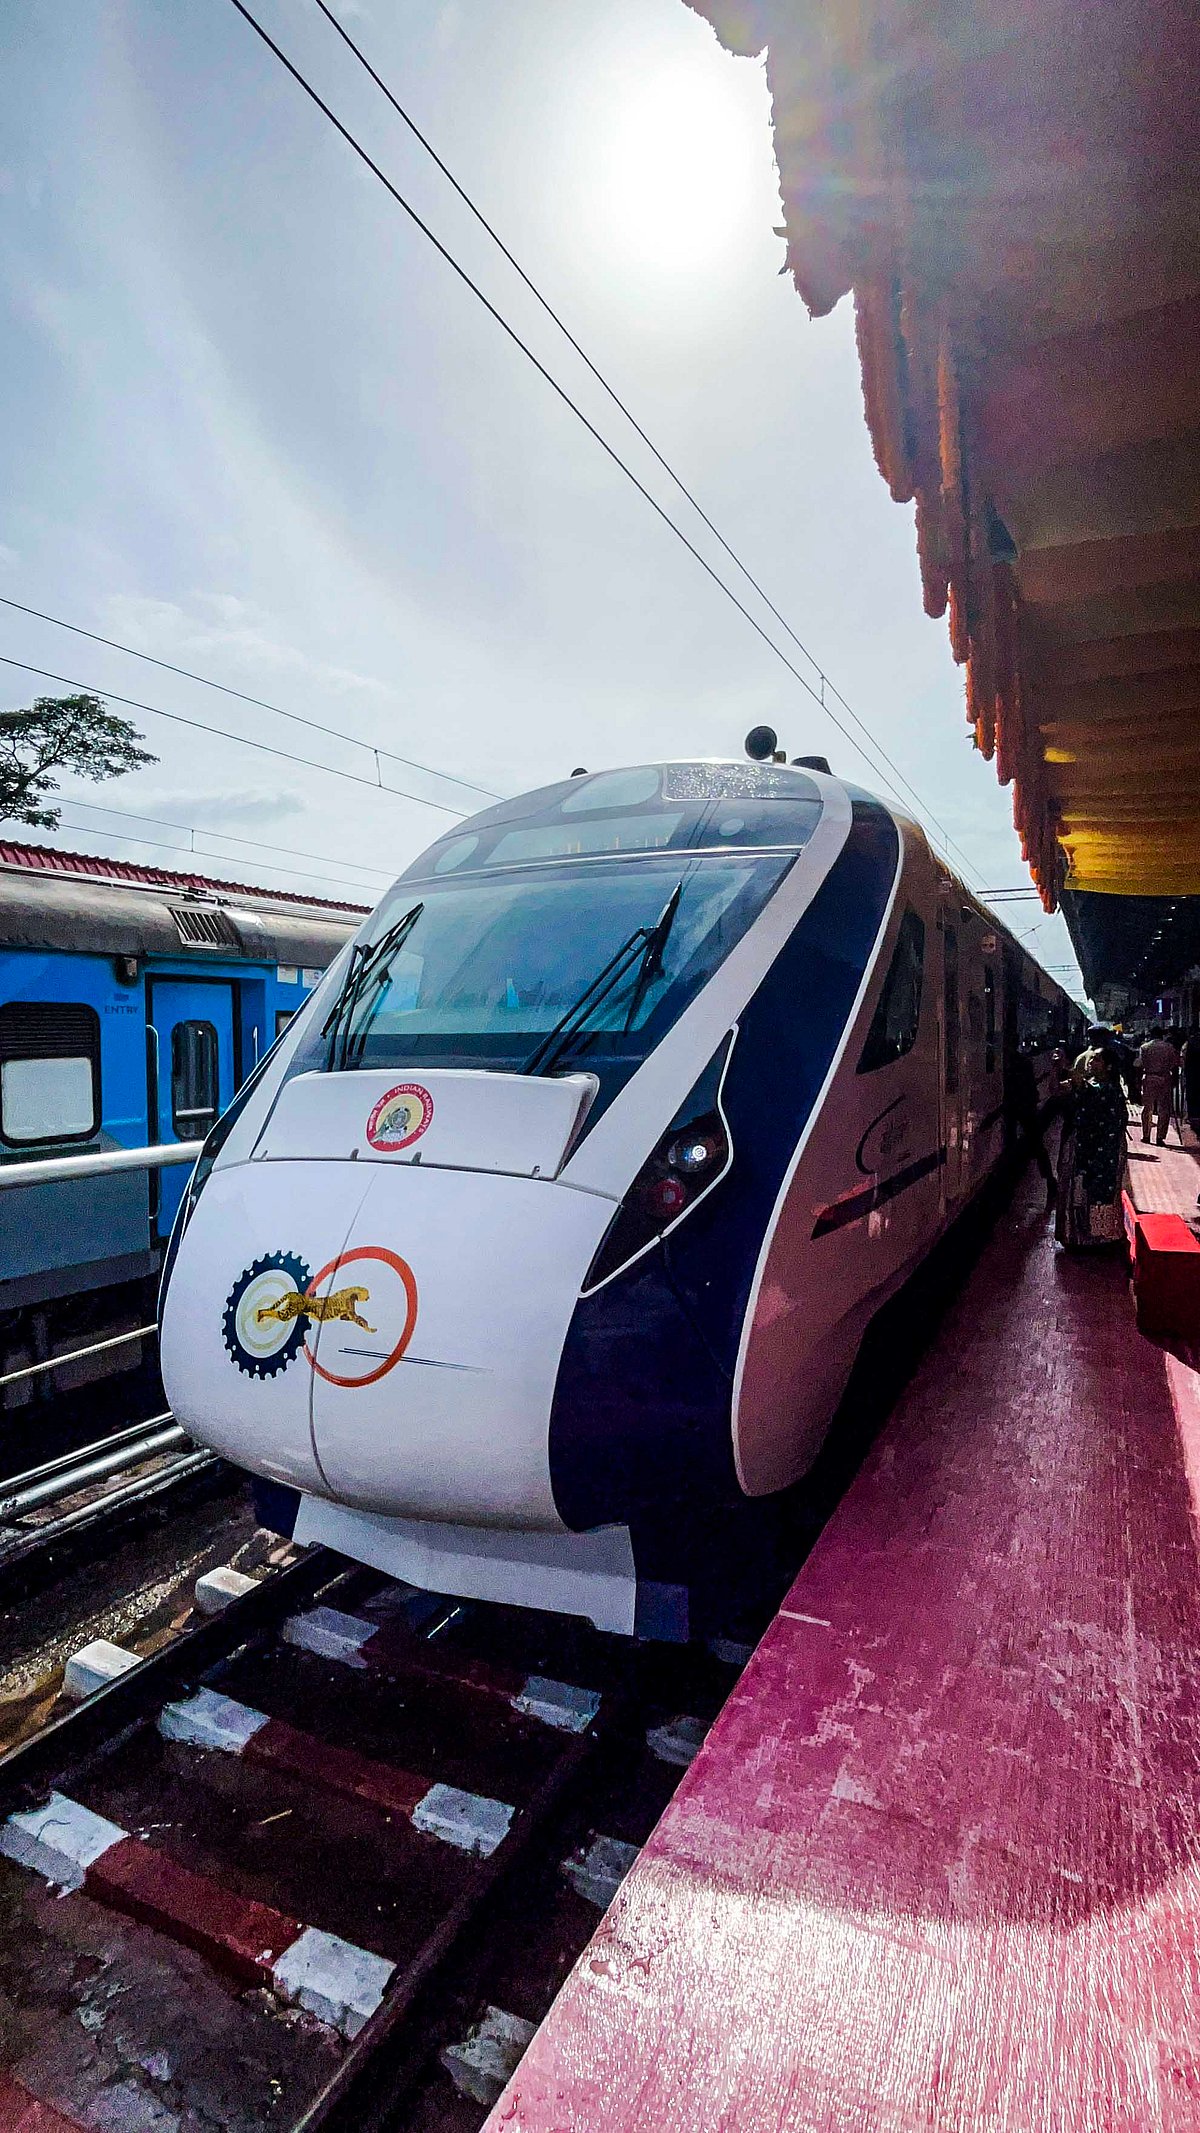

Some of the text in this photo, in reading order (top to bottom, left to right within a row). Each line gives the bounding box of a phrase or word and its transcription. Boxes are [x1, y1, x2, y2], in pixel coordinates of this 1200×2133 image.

[104, 1005, 138, 1014] ENTRY
[394, 1084, 433, 1133] INDIAN RAILWAYS
